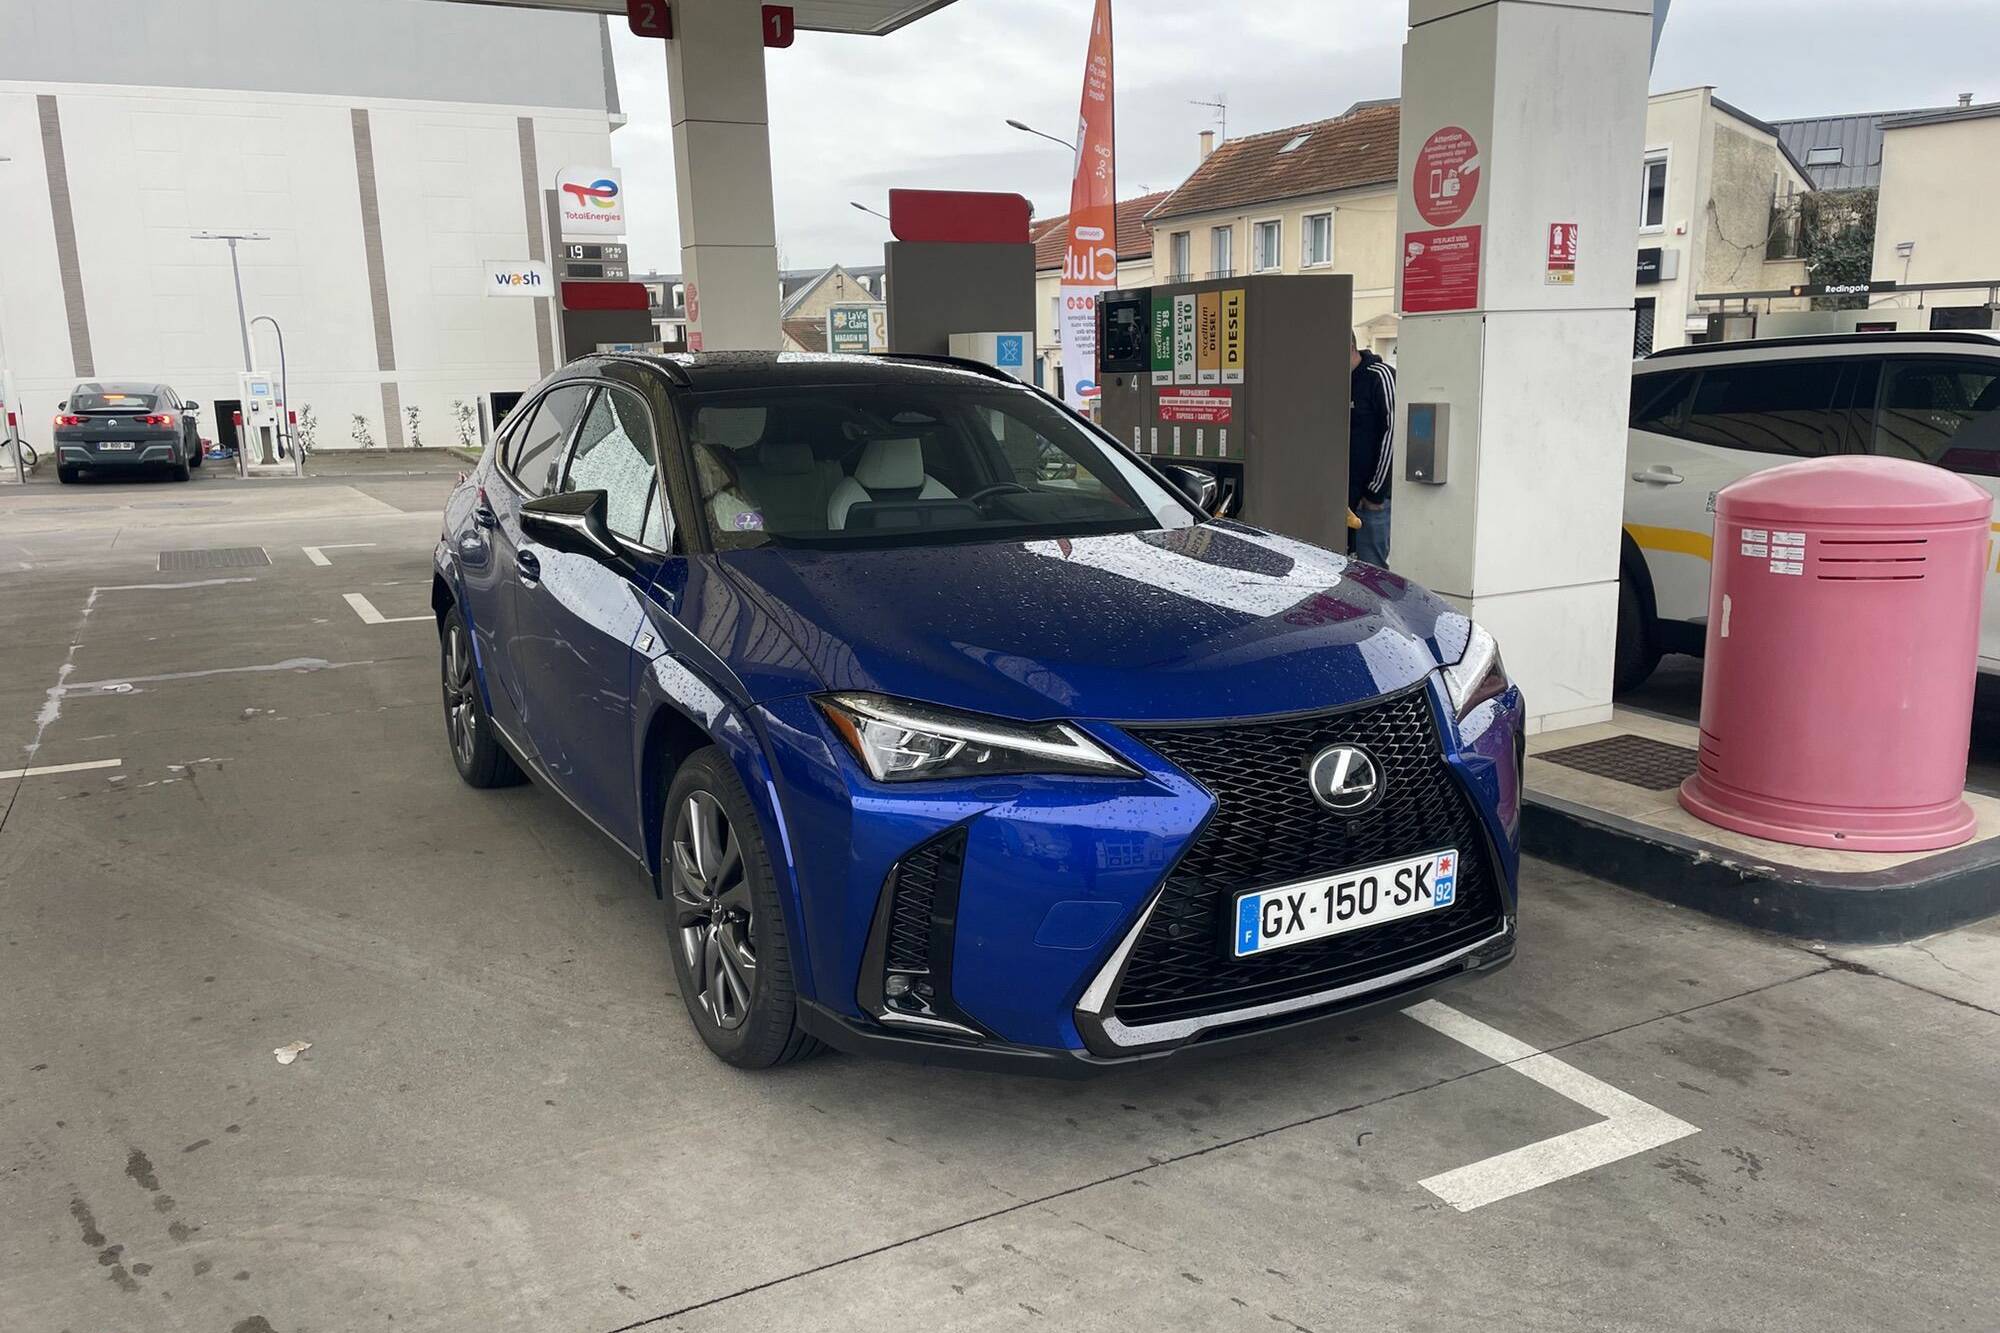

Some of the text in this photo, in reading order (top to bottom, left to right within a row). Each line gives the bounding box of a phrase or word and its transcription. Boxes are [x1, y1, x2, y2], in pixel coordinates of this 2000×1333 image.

[641, 3, 657, 28] 2
[771, 14, 782, 38] 1
[565, 211, 621, 222] TotalEnergies
[495, 270, 541, 286] wash
[1825, 284, 1870, 293] Redingote
[1162, 310, 1170, 328] 98
[1228, 296, 1238, 362] DIESEL
[1154, 311, 1162, 359] excellium
[1183, 303, 1193, 362] 95-E10
[1201, 306, 1209, 357] excellium
[1131, 374, 1138, 391] 4
[1262, 862, 1433, 939] GX-150-SK
[1436, 881, 1452, 902] 92
[1245, 930, 1252, 944] F
